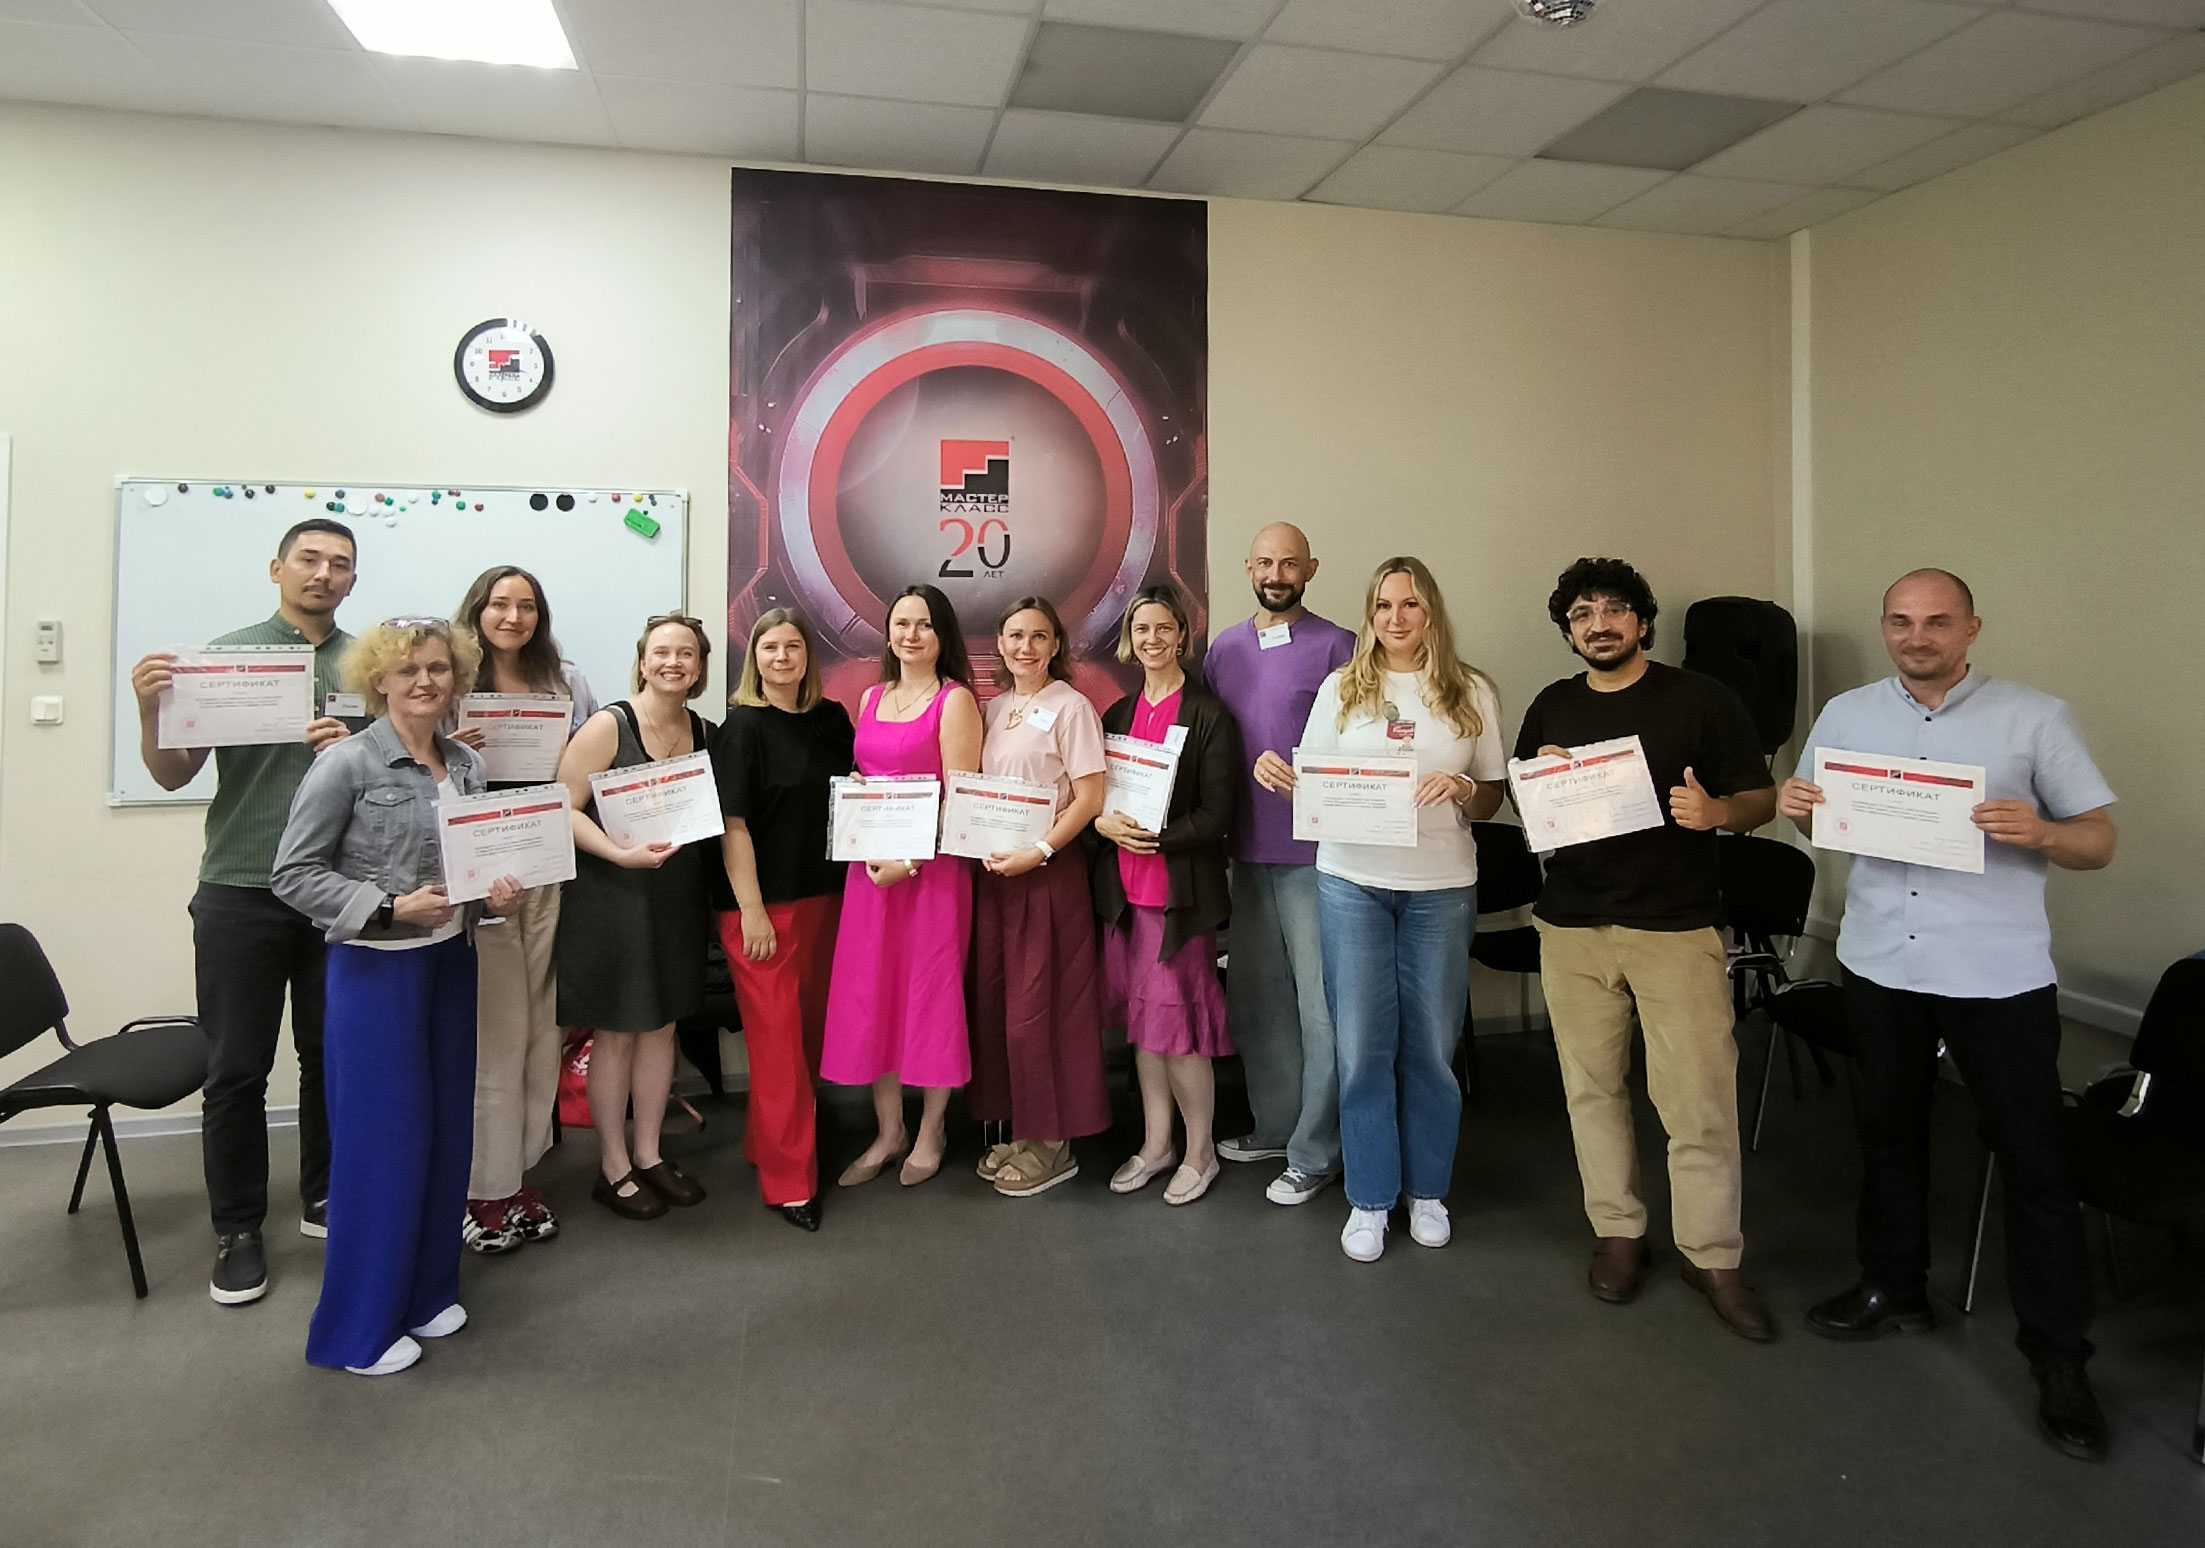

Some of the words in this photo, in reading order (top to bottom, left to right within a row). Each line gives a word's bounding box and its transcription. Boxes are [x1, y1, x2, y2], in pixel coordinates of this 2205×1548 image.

[940, 493, 1009, 503] МАСТЕР
[940, 504, 1009, 513] КЛАСС
[939, 518, 1010, 578] 20
[983, 570, 1005, 579] ЛЕТ
[199, 680, 281, 689] СЕРТИФИКАТ
[487, 723, 544, 731] СЕРТИФИКАТ
[1547, 769, 1615, 790] СЕРТИФИКАТ
[1322, 781, 1388, 791] СЕРТИФИКАТ
[1851, 783, 1942, 801] СЕРТИФИКАТ
[625, 785, 688, 805] СЕРТИФИКАТ
[973, 802, 1031, 817] СЕРТИФИКАТ
[473, 819, 542, 838] СЕРТИФИКАТ
